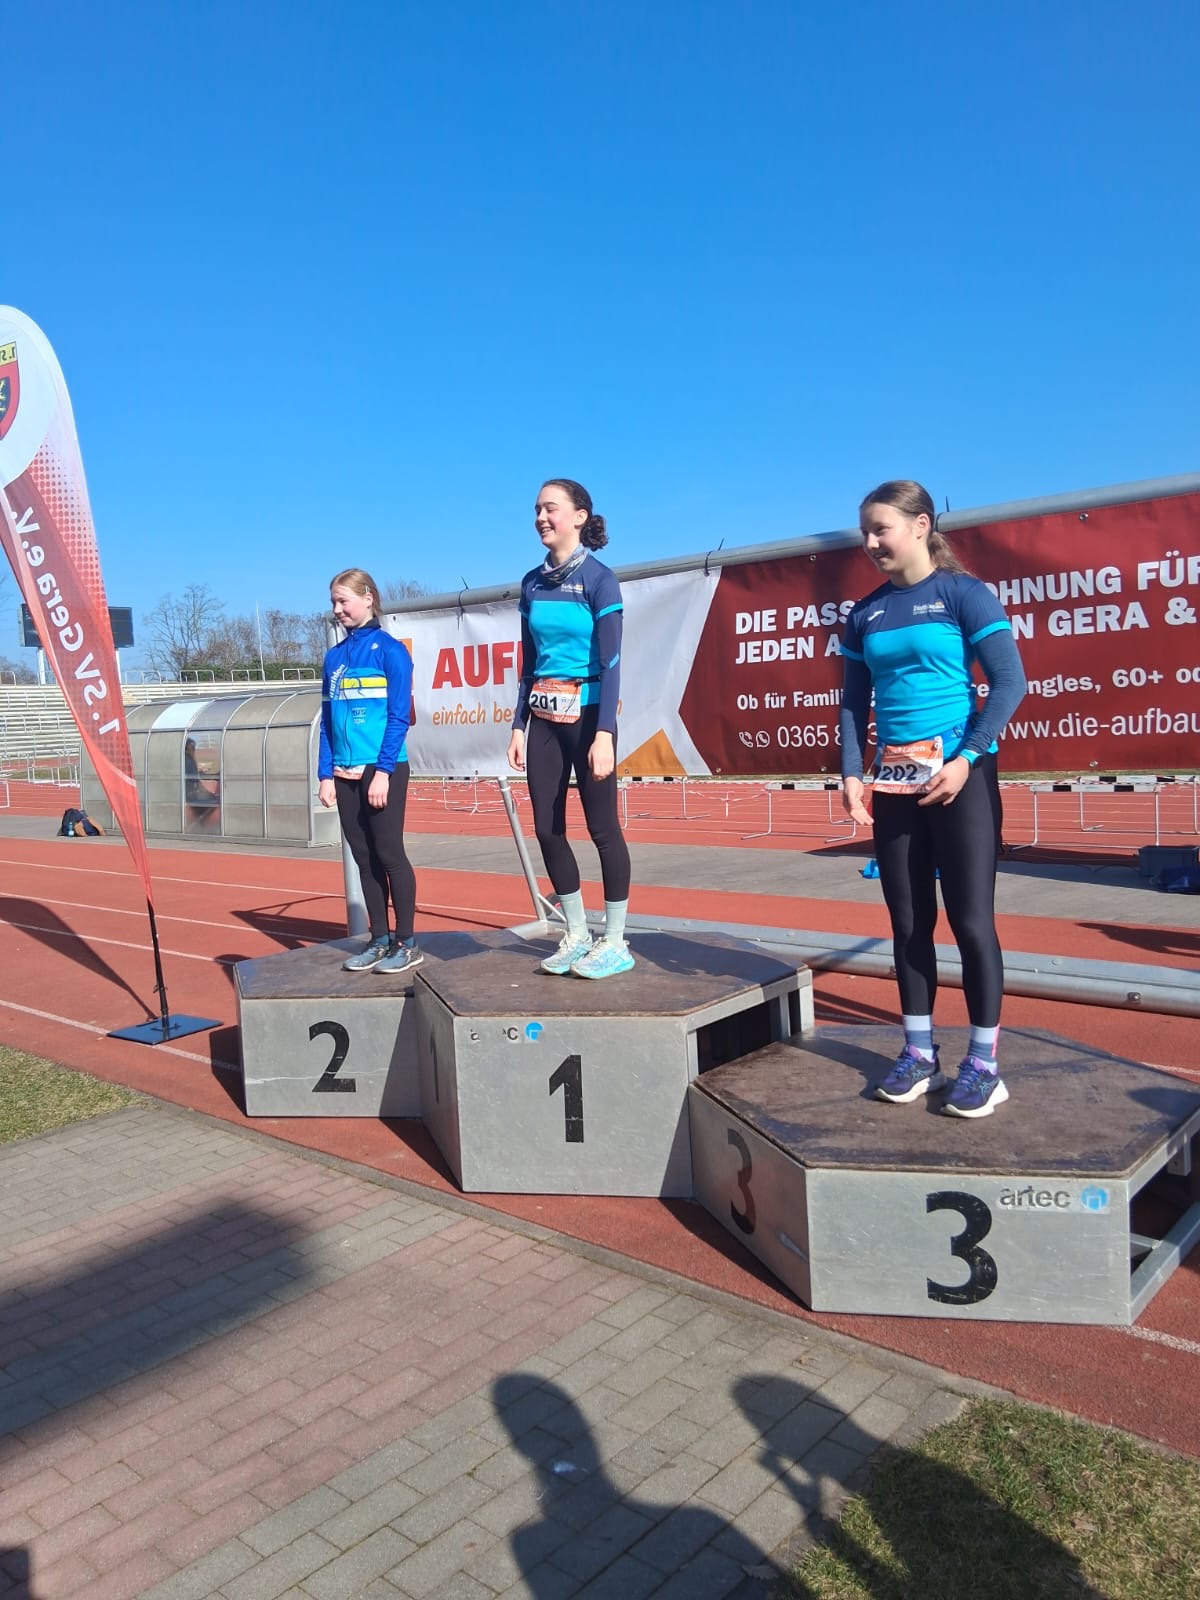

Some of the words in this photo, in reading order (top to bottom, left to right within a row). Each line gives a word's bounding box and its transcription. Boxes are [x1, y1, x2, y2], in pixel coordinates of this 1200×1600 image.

[735, 609, 777, 635] DIE
[786, 599, 862, 630] PASS
[735, 636, 815, 665] JEDEN
[824, 634, 843, 657] A
[1007, 612, 1034, 641] N
[1047, 601, 1149, 637] GERA
[1164, 597, 1197, 626] &
[431, 640, 523, 690] AUF
[530, 693, 558, 712] 201
[736, 694, 758, 711] Ob
[764, 692, 786, 710] für
[793, 688, 844, 708] Famili
[1028, 674, 1101, 698] ngles,
[1111, 667, 1164, 688] 60+
[432, 701, 486, 726] einfach
[493, 701, 517, 724] be
[777, 724, 830, 748] 0365
[880, 763, 918, 782] 202
[308, 1020, 356, 1093] 2
[549, 1054, 585, 1143] 1
[728, 1129, 757, 1236] 3
[999, 1186, 1071, 1209] artec
[926, 1190, 998, 1306] 3
